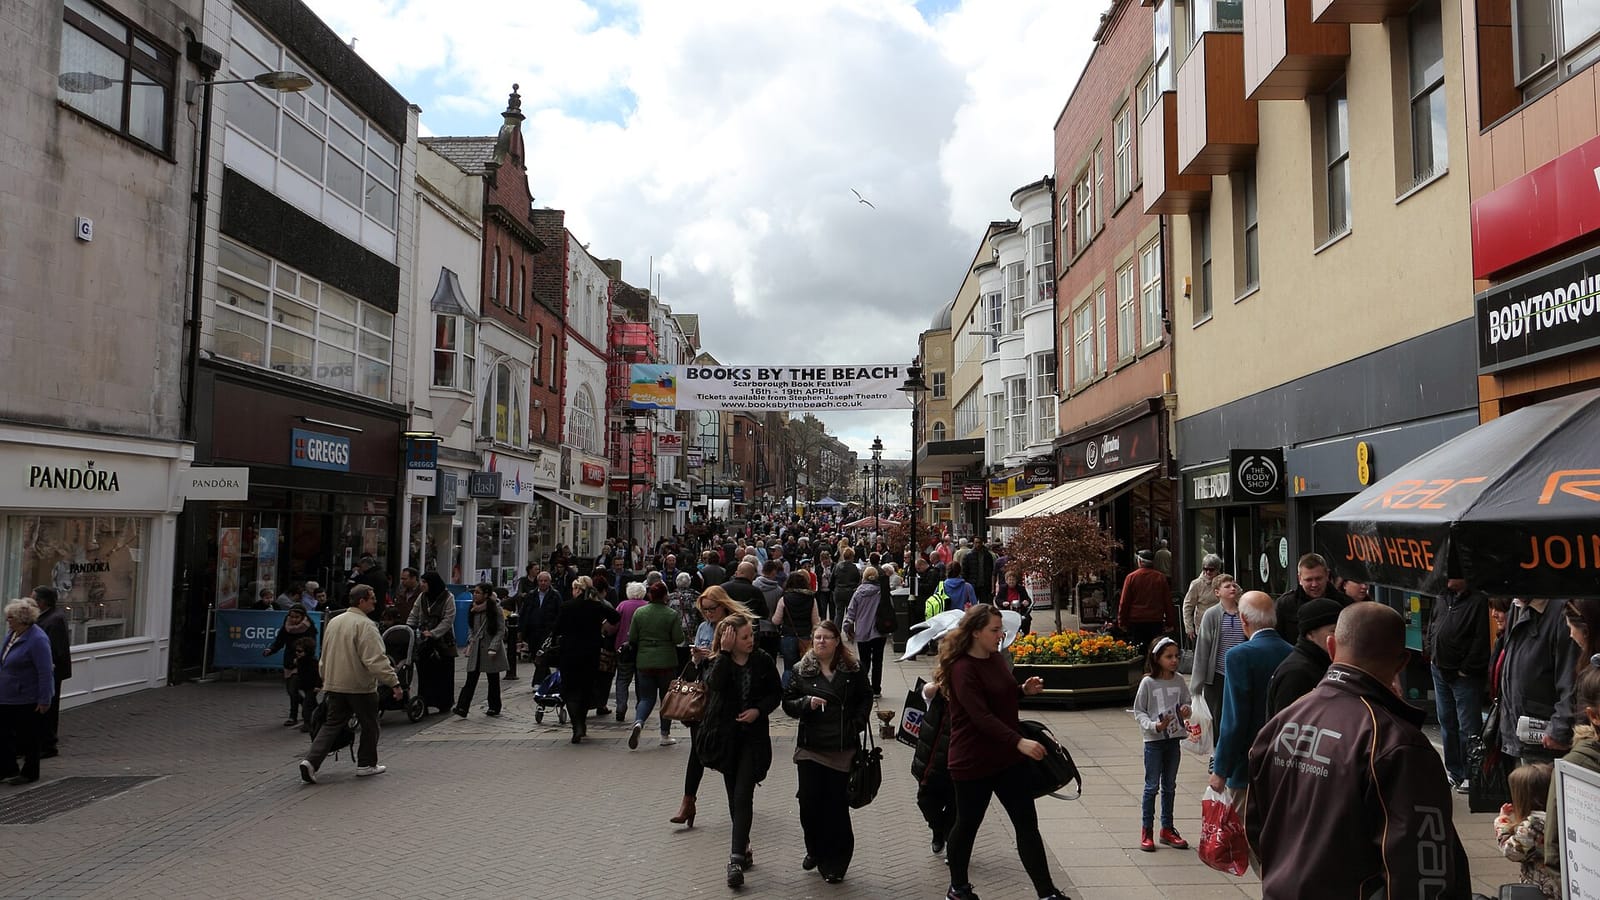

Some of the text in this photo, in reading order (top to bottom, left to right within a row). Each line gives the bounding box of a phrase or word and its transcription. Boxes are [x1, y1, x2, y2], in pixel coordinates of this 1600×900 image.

[686, 367, 898, 380] BOOKS BY THE BEACH
[721, 401, 863, 409] www.booksbythebeach.co.uk
[659, 435, 681, 444] PAS
[307, 438, 349, 465] GREGGS
[409, 460, 435, 469] GREGGS
[30, 464, 120, 491] PANDORA
[192, 477, 240, 488] PANDORA
[1246, 473, 1271, 481] BODY
[474, 477, 495, 494] dash
[1193, 475, 1211, 500] THE
[1247, 480, 1270, 488] SHOP
[1345, 532, 1435, 572] JOIN HERE
[69, 560, 110, 574] PANDORA
[1274, 756, 1285, 767] the
[1305, 763, 1329, 778] people
